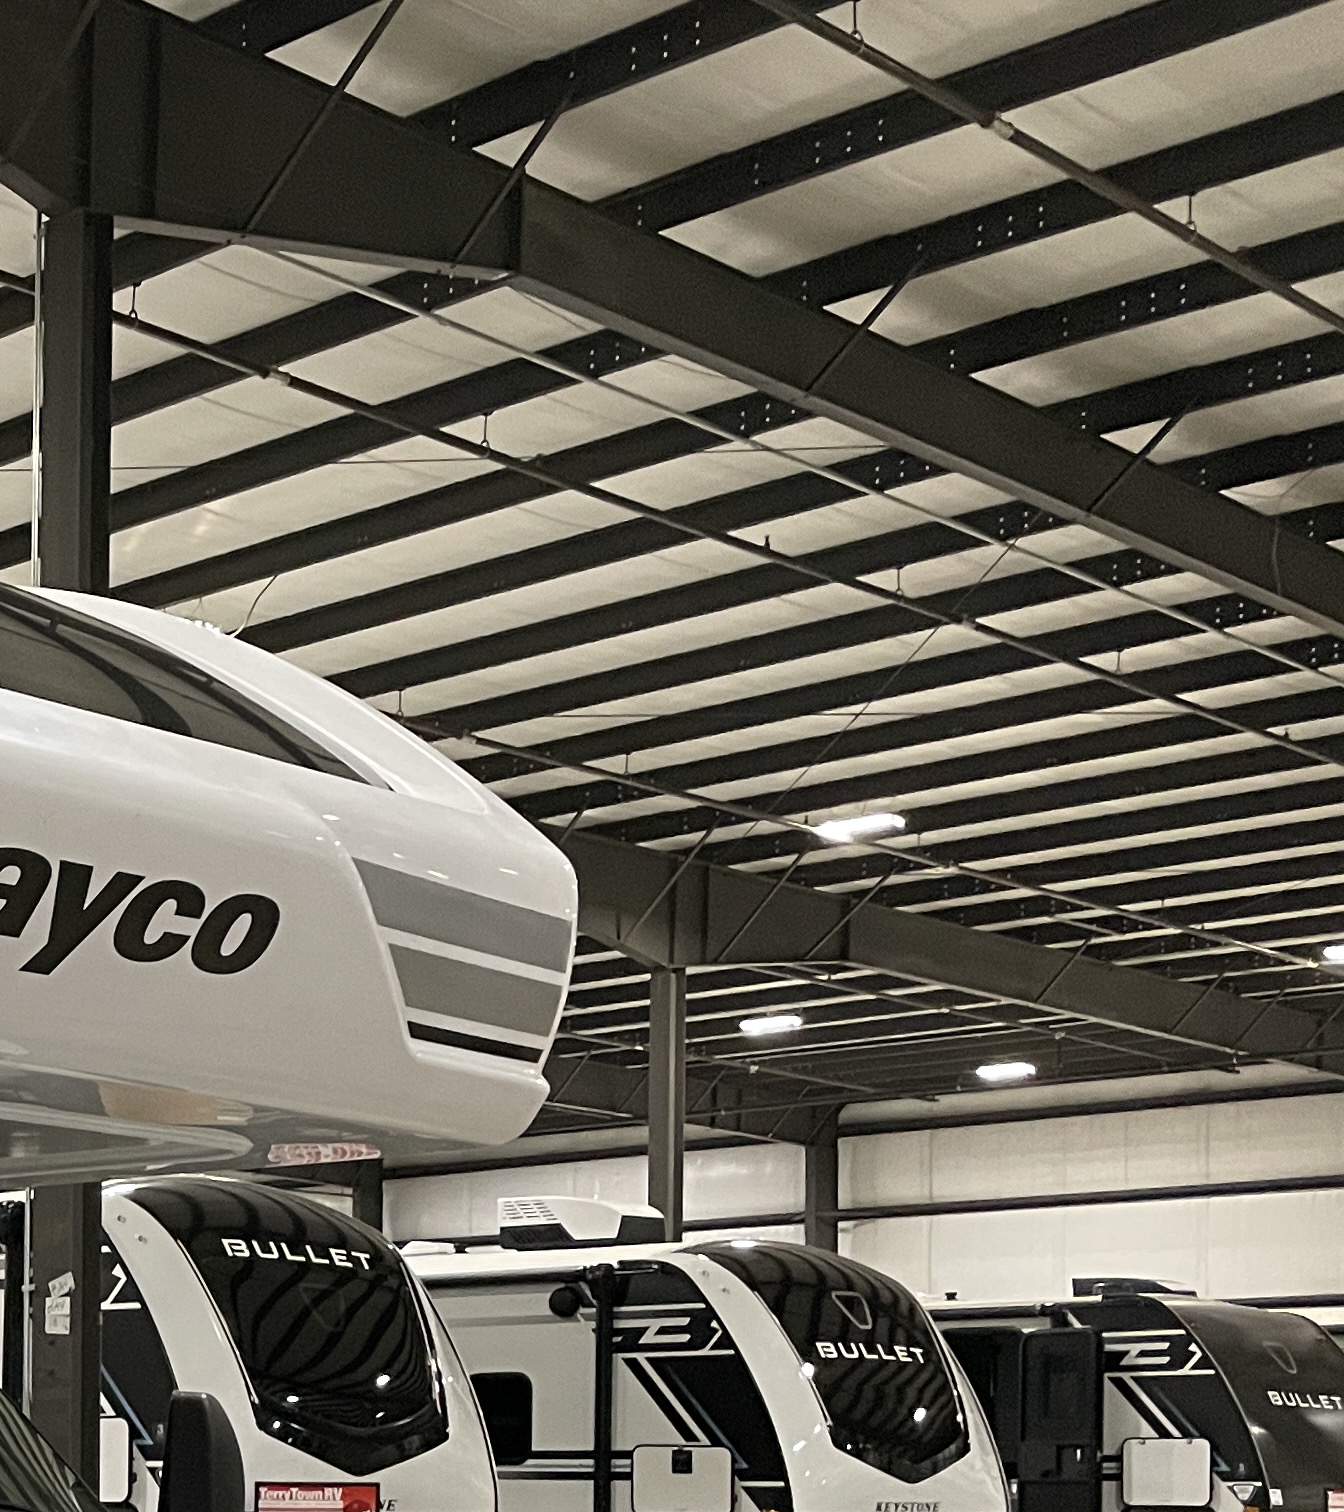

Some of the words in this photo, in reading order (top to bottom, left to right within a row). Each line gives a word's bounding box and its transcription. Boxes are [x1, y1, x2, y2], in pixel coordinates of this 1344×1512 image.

[220, 1238, 371, 1271] BULLET
[815, 1341, 925, 1364] BULLET
[1267, 1390, 1343, 1410] BULLET
[323, 1487, 343, 1501] RV
